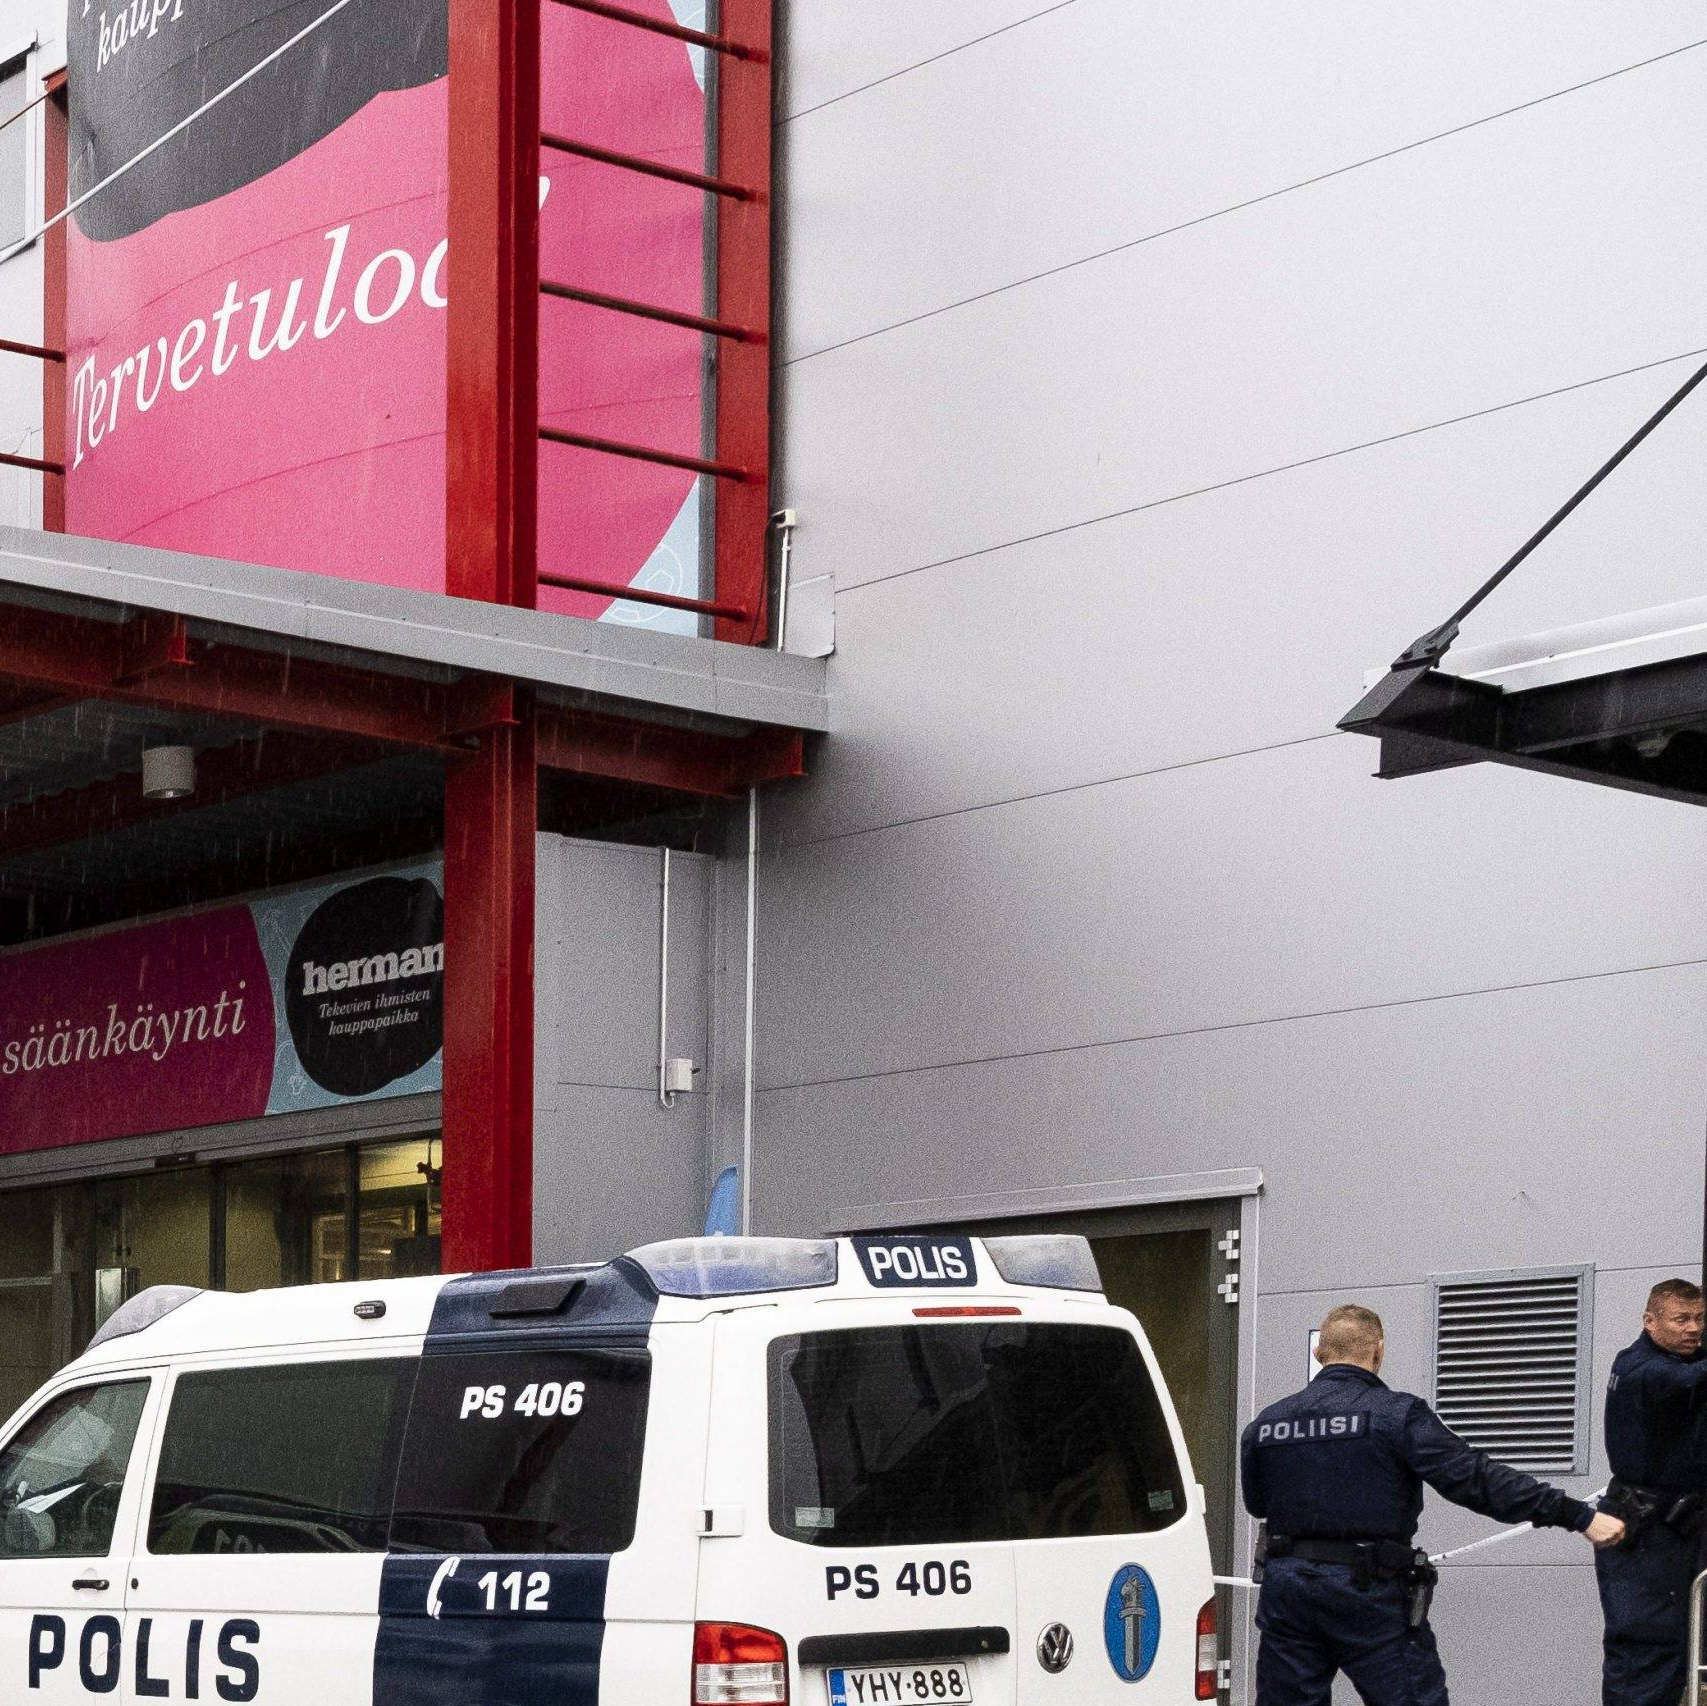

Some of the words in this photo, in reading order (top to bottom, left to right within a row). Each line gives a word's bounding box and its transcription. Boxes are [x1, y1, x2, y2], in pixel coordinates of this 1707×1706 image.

[319, 1000, 372, 1019] Tekevien
[375, 989, 431, 1010] ihmisten
[329, 1009, 419, 1036] kauppapaikka
[867, 1246, 968, 1280] POLIS
[459, 1385, 506, 1419] PS
[514, 1381, 585, 1417] 406
[1259, 1415, 1358, 1442] POLIISI
[477, 1571, 550, 1611] 112
[825, 1563, 879, 1600] PS
[895, 1560, 972, 1597] 406
[28, 1614, 261, 1702] POLIS
